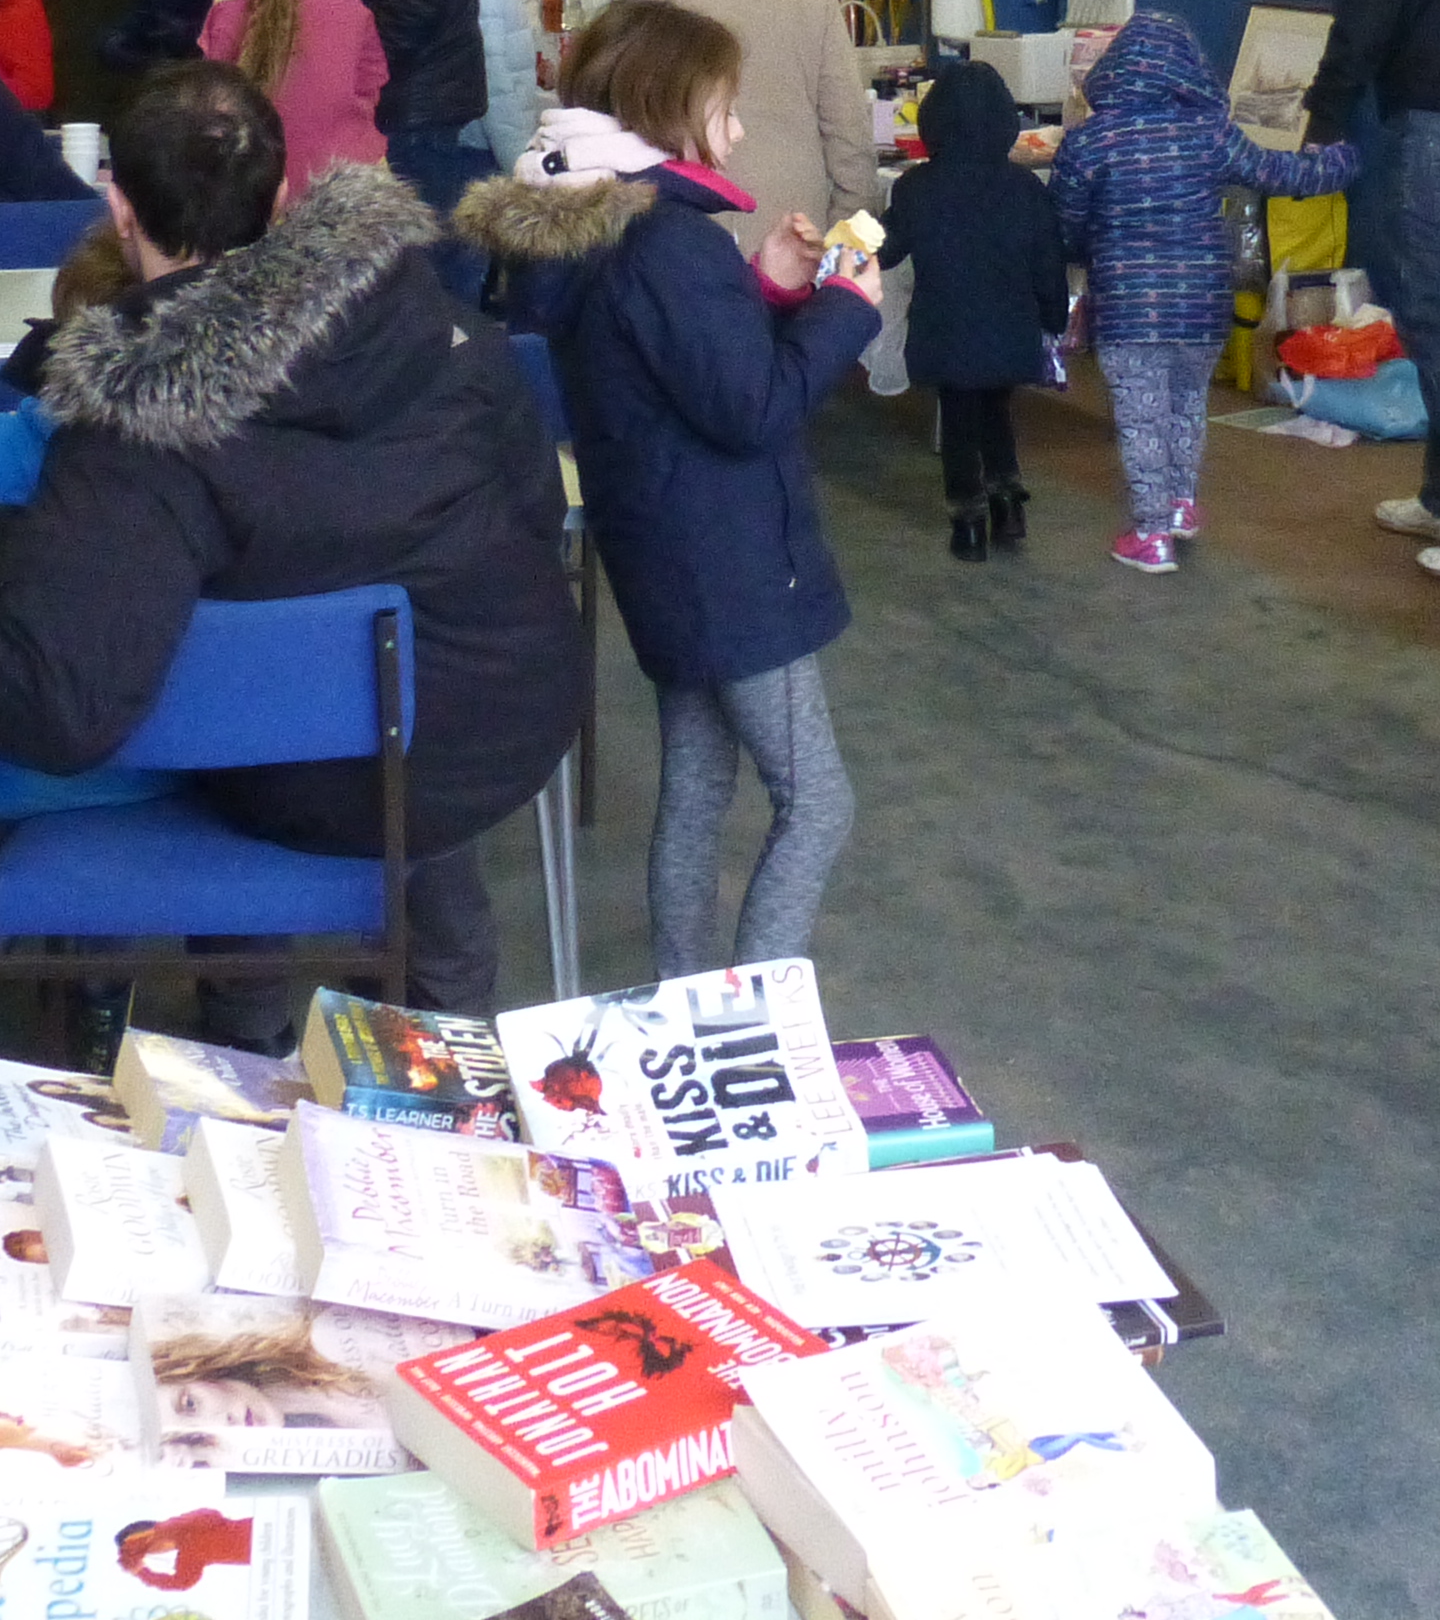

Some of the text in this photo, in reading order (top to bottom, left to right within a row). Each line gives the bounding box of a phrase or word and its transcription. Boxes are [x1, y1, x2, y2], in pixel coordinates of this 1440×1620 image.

[434, 1015, 514, 1098] STOLEN
[686, 974, 797, 1141] & DIE
[771, 964, 854, 1136] LEE WEEKS
[375, 1106, 455, 1131] LEARNER
[638, 1043, 729, 1157] KISS
[343, 1146, 381, 1220] Debbie
[369, 1125, 424, 1262] Macomber
[448, 1149, 490, 1236] the Road
[346, 1277, 441, 1310] Macomber
[470, 1294, 512, 1317] Turn
[433, 1345, 610, 1467] JONATHAN
[503, 1330, 649, 1417] HOLT
[242, 1447, 399, 1469] GREYLADIES
[570, 1471, 602, 1530] THE
